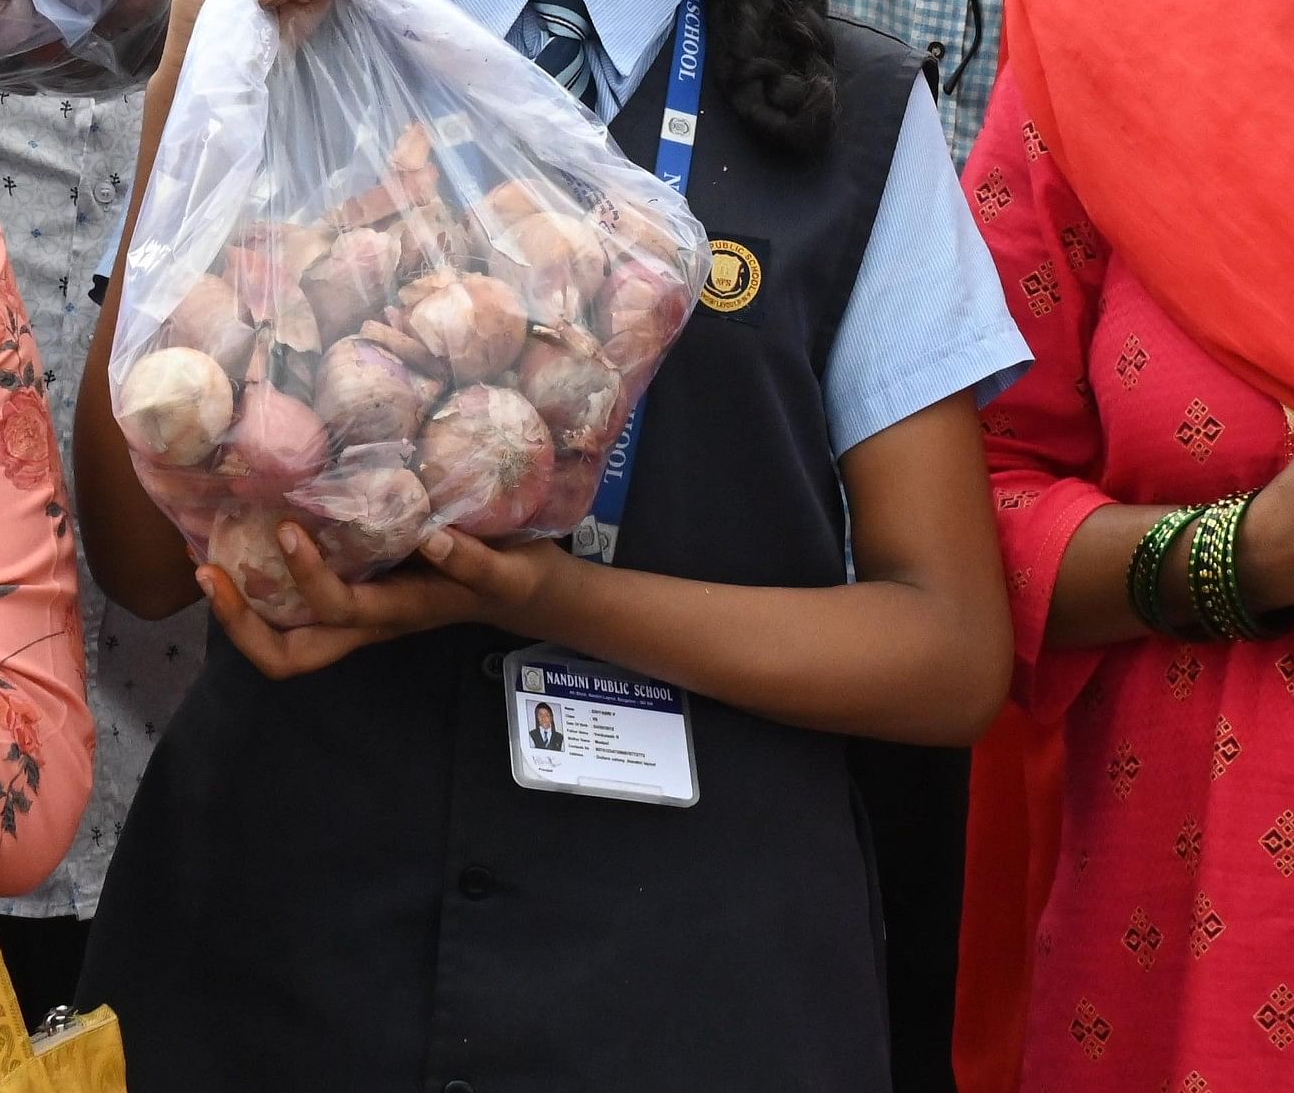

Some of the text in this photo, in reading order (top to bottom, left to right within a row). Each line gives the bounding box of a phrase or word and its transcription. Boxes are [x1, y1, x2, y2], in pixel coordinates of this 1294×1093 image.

[678, 0, 701, 82] SCHOOL
[745, 253, 760, 292] SCHOOL
[546, 671, 589, 689] NANDINI
[594, 676, 630, 695] PUBLIC
[634, 684, 674, 702] SCHOOL
